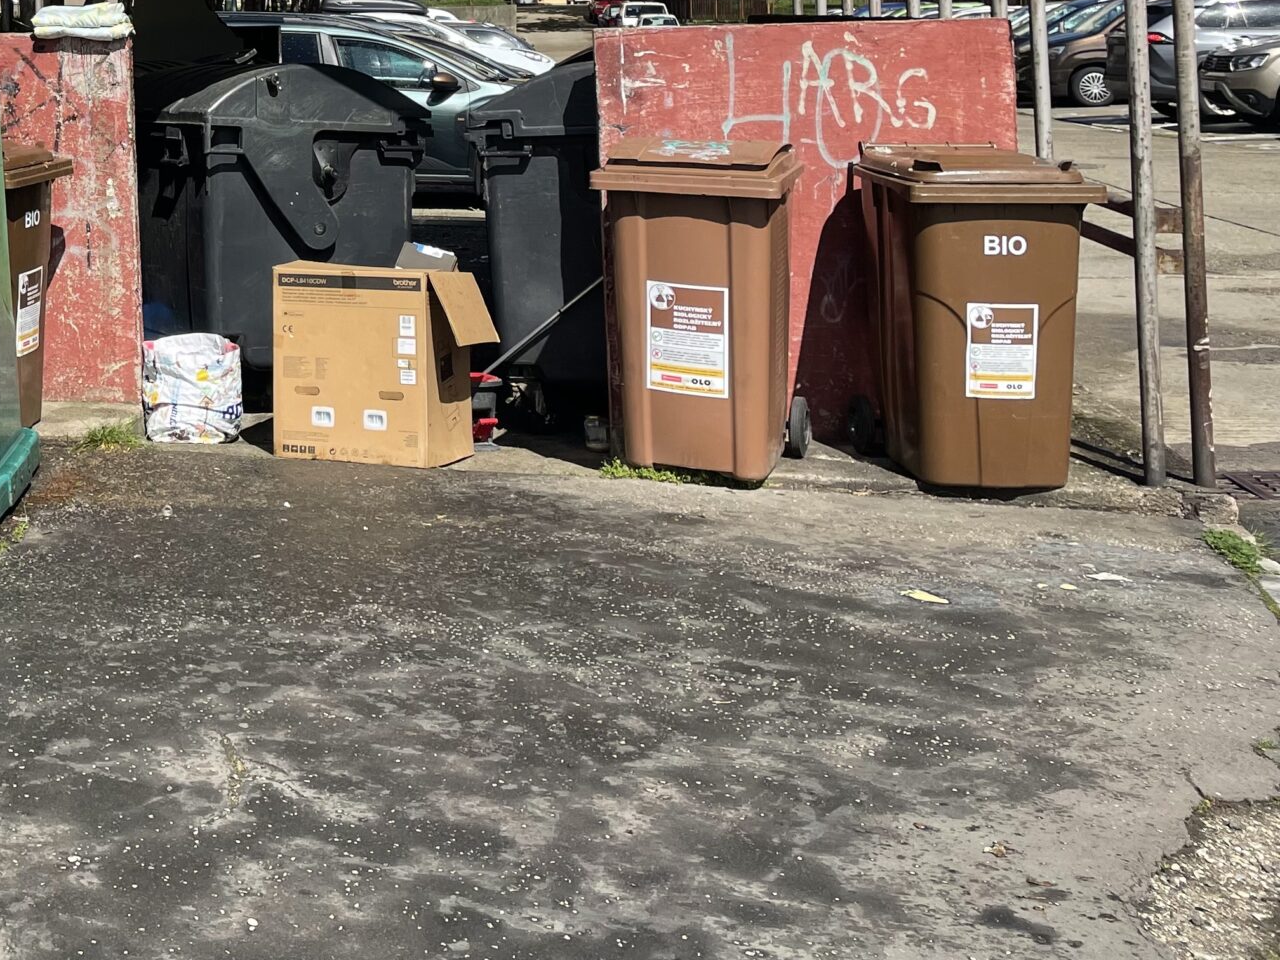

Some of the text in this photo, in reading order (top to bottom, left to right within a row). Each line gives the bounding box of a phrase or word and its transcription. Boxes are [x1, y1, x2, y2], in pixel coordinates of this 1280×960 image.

[24, 209, 40, 228] BIO
[983, 235, 1027, 256] BIO
[392, 278, 417, 287] brother
[691, 378, 711, 386] OLO
